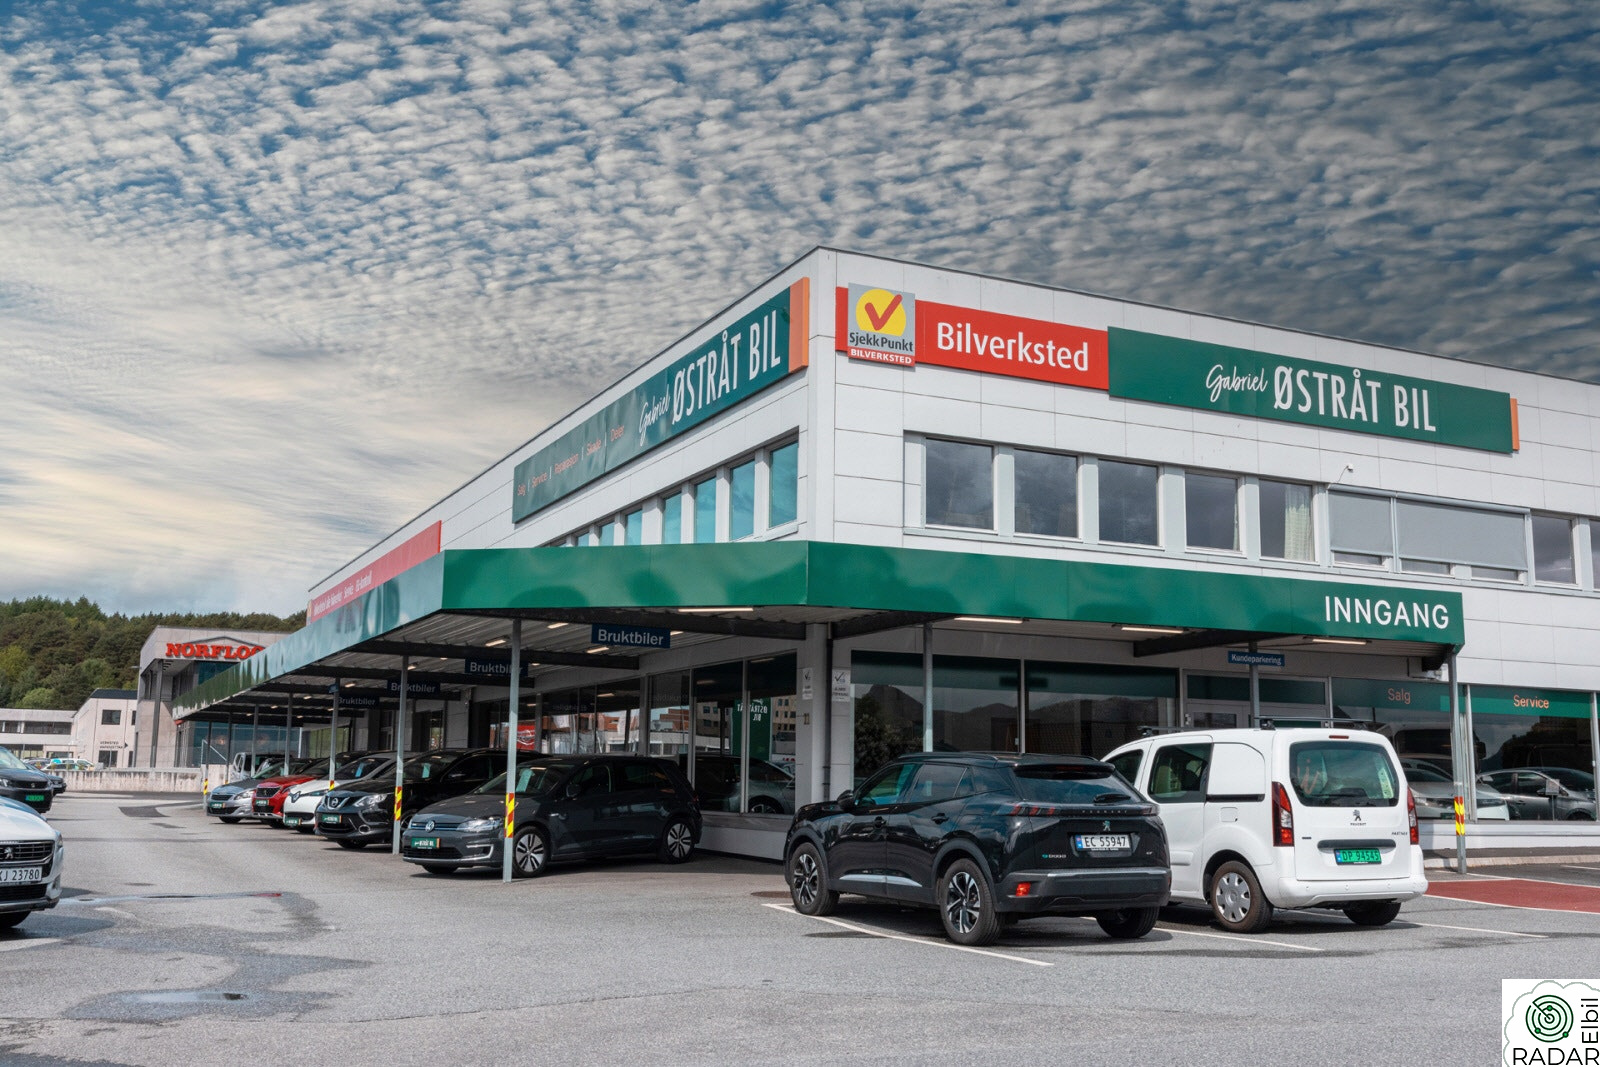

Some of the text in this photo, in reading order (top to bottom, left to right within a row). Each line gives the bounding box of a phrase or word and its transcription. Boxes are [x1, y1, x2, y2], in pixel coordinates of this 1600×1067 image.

[937, 322, 1089, 372] Bilverksted
[850, 349, 913, 365] BILVERKSTED
[671, 329, 742, 425] ØSTRÅT
[749, 310, 781, 380] BIL
[1206, 364, 1437, 433] Gabriel ØSTRÅT BIL
[1325, 596, 1449, 630] INNGANG
[597, 629, 664, 646] Bruktbiler
[1231, 654, 1283, 667] Kundeparkering
[469, 662, 523, 675] Bruktbilr
[391, 683, 436, 694] Brktbiler
[1387, 688, 1411, 705] Salg
[1513, 695, 1550, 709] Service
[1084, 836, 1126, 847] EC 55947
[1342, 850, 1379, 861] DP 94545
[12, 869, 40, 881] 23780
